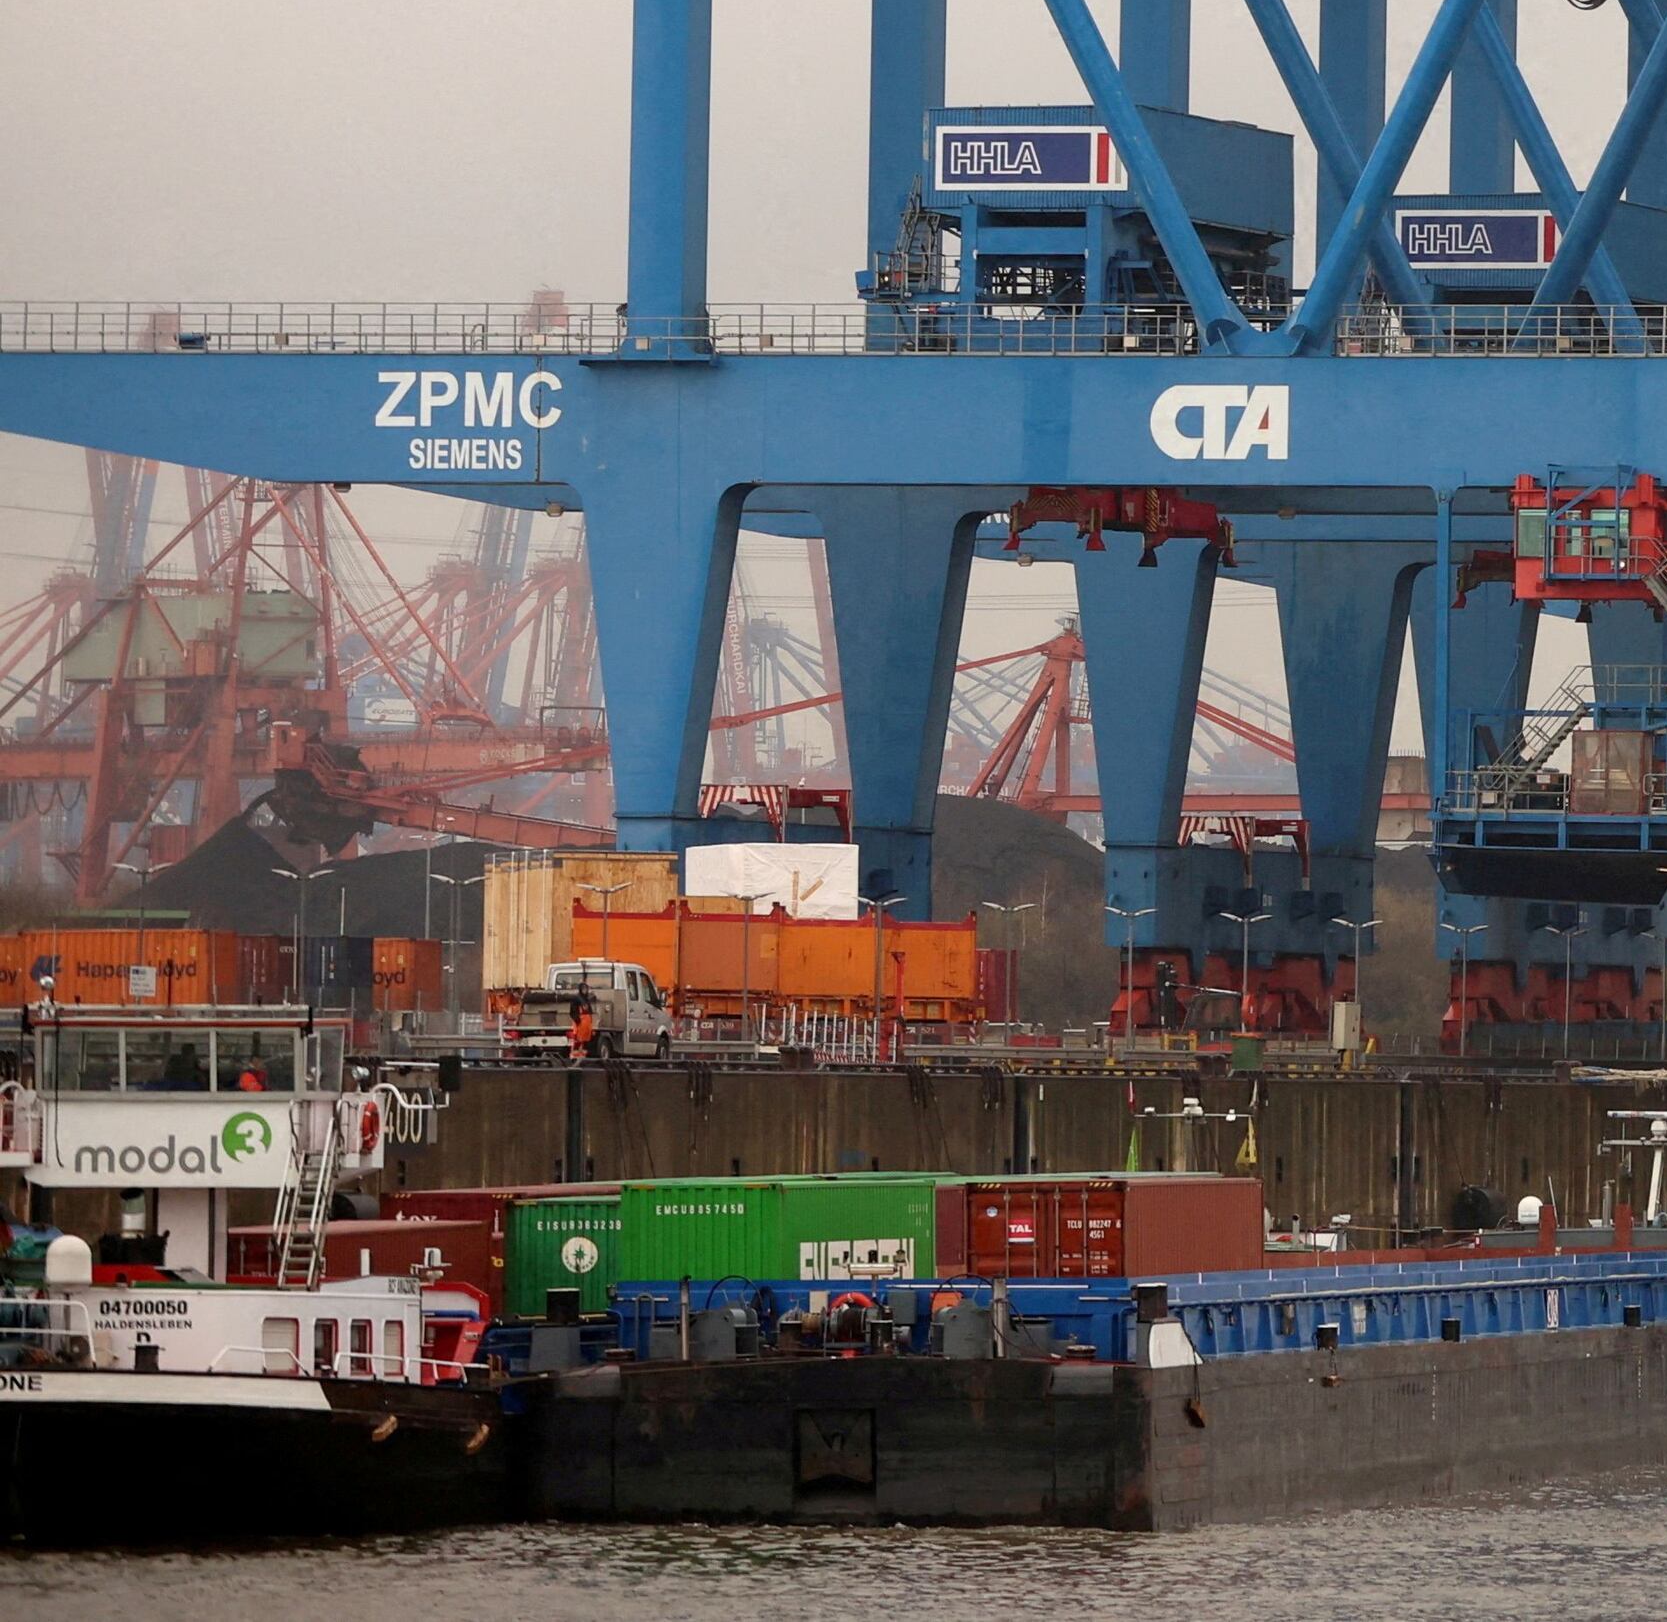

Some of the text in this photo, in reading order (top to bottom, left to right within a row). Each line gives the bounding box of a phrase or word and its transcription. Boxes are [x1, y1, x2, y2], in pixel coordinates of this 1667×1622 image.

[949, 141, 1042, 177] HHLA
[1407, 224, 1493, 255] HHLA
[374, 371, 563, 430] ZPMC
[1150, 383, 1291, 461] CTA
[408, 438, 523, 472] SIEMENS
[74, 1135, 223, 1174] modal
[1009, 1224, 1033, 1233] TAL
[94, 1319, 193, 1330] HALDENSLEBEN
[99, 1299, 188, 1316] 04700050
